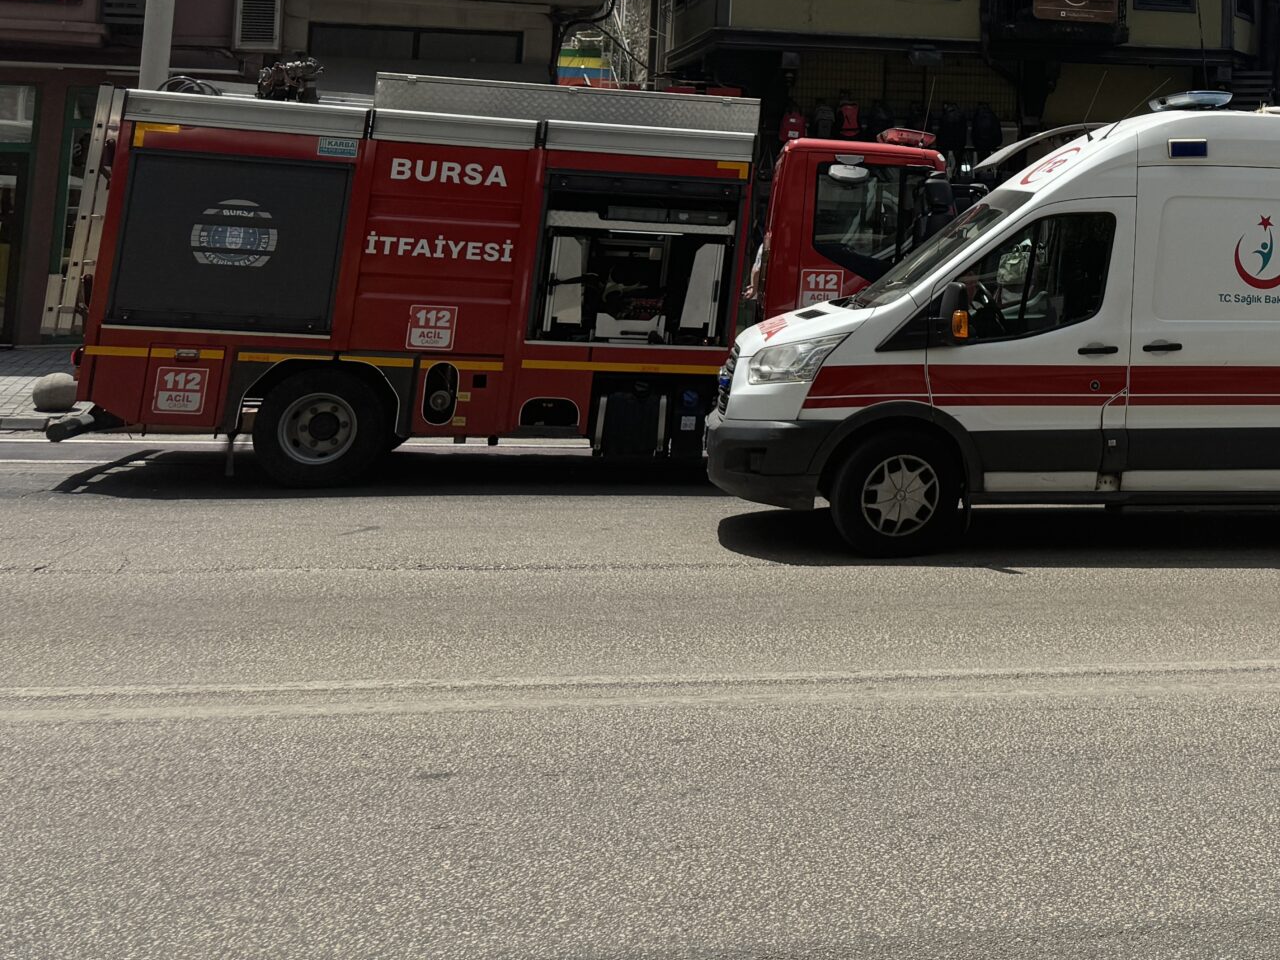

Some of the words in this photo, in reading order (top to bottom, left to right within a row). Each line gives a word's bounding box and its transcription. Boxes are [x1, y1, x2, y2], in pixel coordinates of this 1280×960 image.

[390, 157, 508, 188] BURSA
[365, 230, 514, 263] İTFAİYESİ
[807, 273, 838, 289] 112
[1234, 294, 1262, 305] Sağlık
[416, 309, 451, 327] 112
[419, 330, 443, 339] ACİL
[164, 371, 201, 390] 112
[166, 393, 192, 403] ACİL
